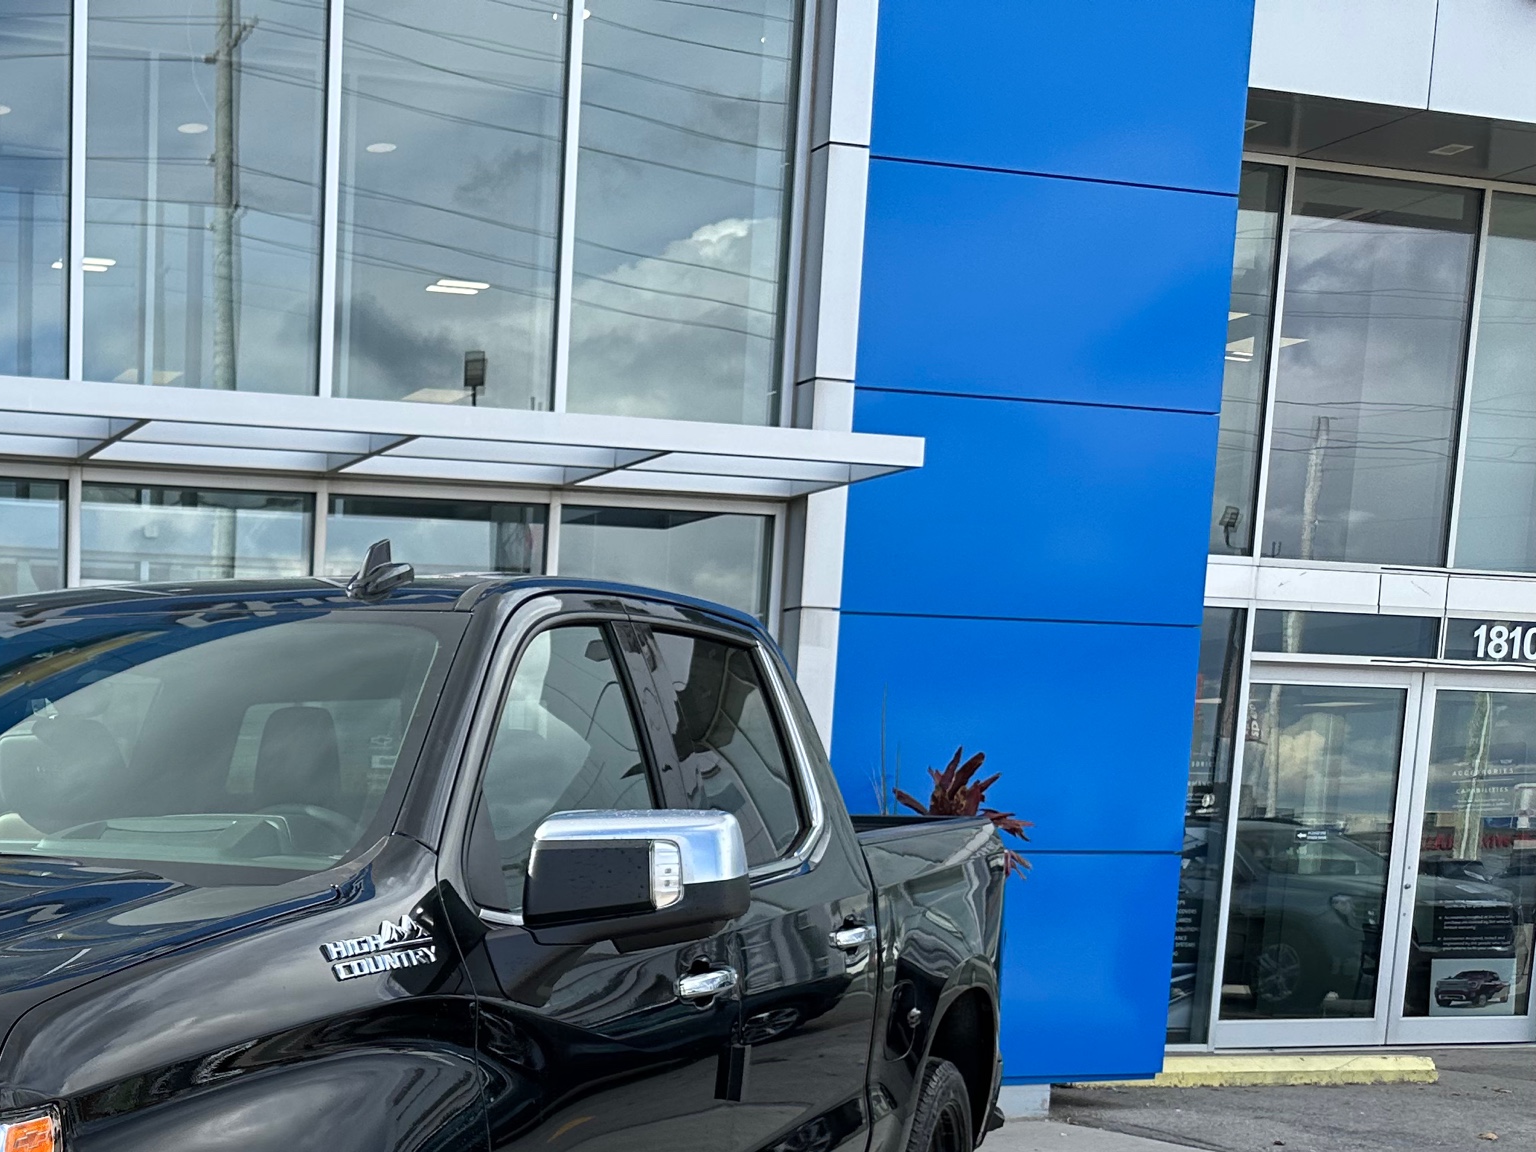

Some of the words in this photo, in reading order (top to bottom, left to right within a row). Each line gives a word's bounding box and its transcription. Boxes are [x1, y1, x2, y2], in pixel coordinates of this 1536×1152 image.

[1473, 624, 1536, 661] 1810
[319, 933, 385, 962] HIGH
[331, 944, 437, 982] COUNTRY
